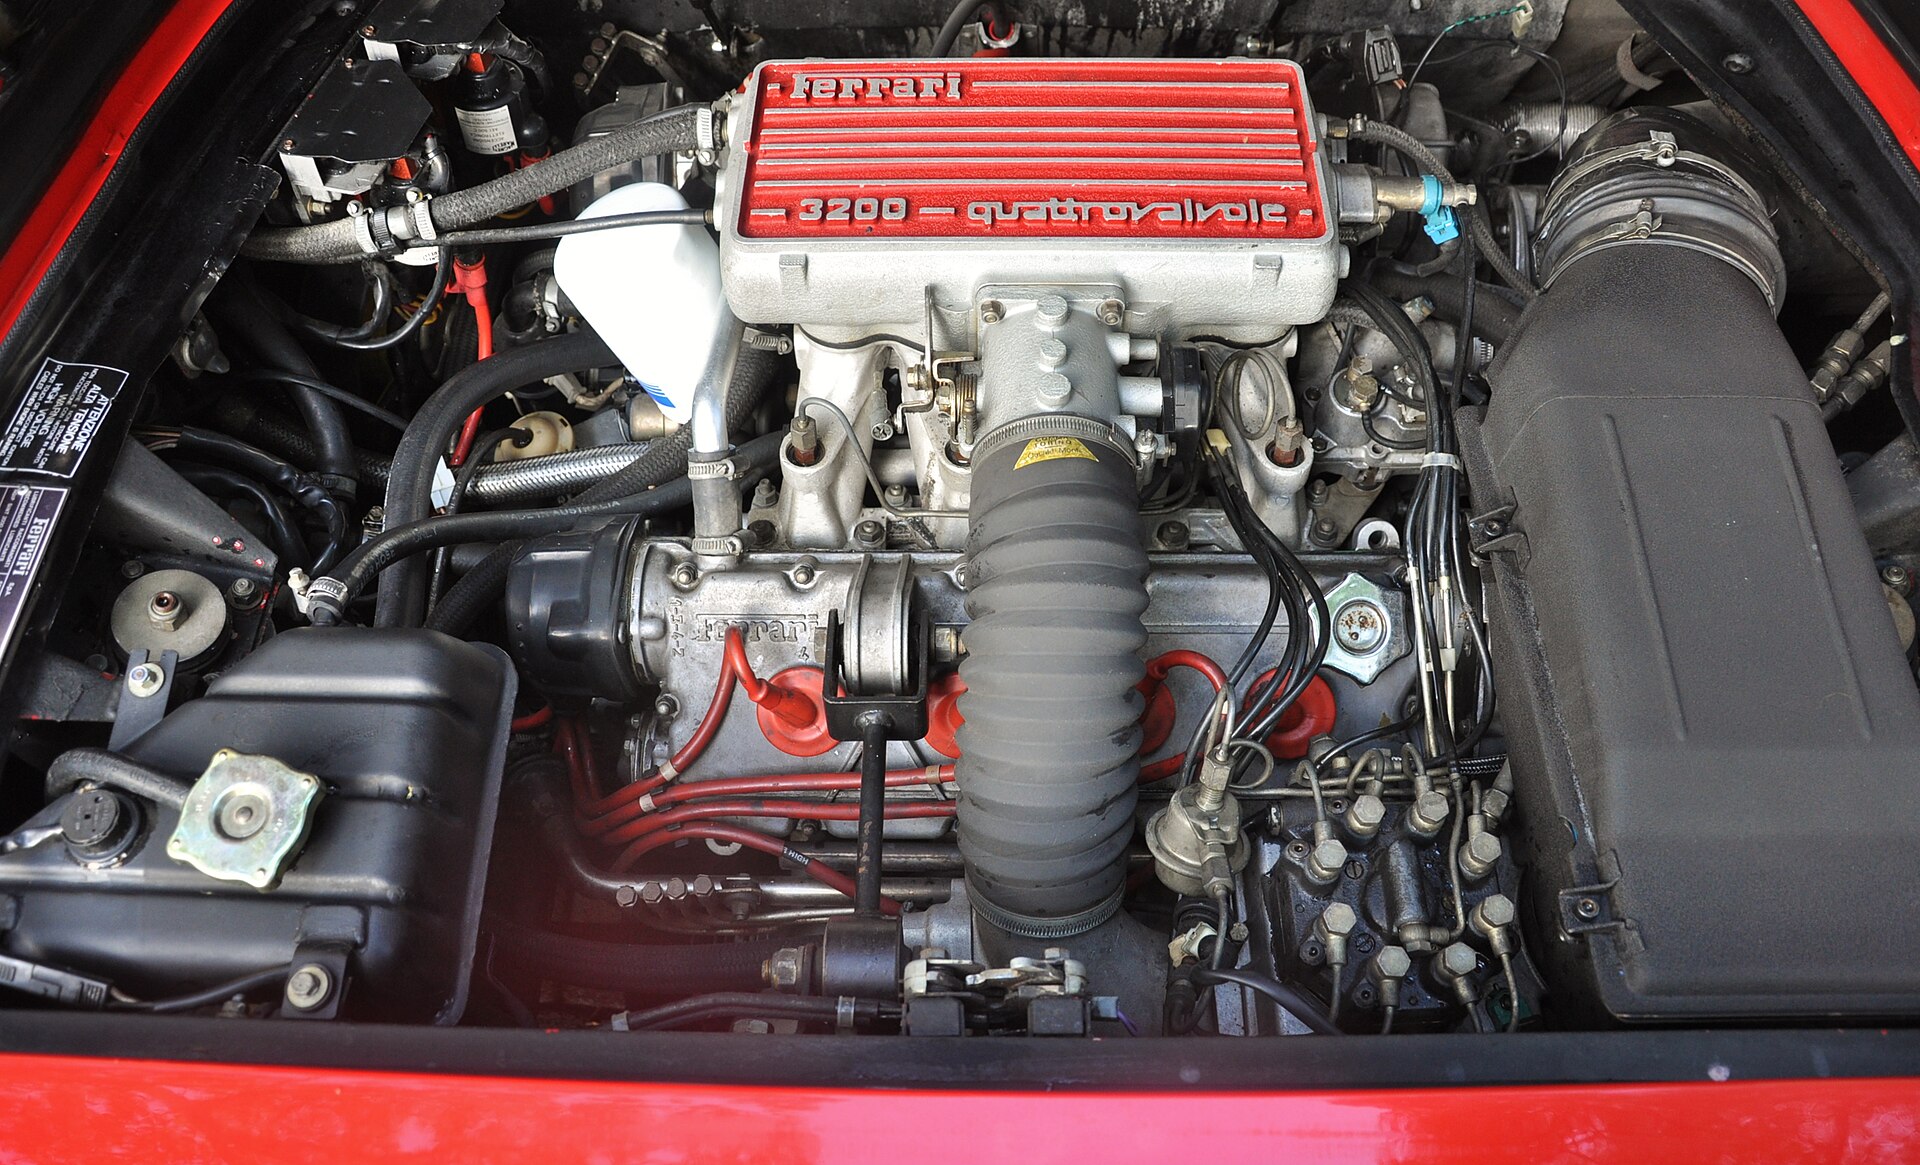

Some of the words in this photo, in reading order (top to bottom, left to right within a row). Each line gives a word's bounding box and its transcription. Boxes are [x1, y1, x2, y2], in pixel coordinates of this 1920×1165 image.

[790, 72, 961, 99] Ferrari
[799, 198, 906, 220] 3200
[967, 197, 1287, 225] quattrovalvole
[47, 373, 57, 383] NOT
[54, 364, 62, 372] DO
[87, 367, 98, 378] NON
[35, 370, 51, 389] CABLES
[26, 391, 39, 406] WHEN
[37, 384, 51, 400] TOUCH
[44, 382, 63, 404] HIGH
[82, 383, 102, 404] ALTA
[15, 407, 30, 425] ENGINE
[32, 401, 41, 410] OR
[37, 392, 68, 436] WARNING
[58, 406, 68, 418] CON
[14, 411, 35, 442] DISCONNECT
[19, 407, 49, 448] VOLTAGE
[45, 419, 61, 440] MOTORE
[54, 406, 89, 454] TENSIONE
[69, 394, 110, 451] ATTENZIONE
[1, 444, 17, 466] IGNITION
[552, 500, 621, 516] AUSTRALIA
[10, 515, 51, 577] Ferrari
[374, 548, 396, 569] HOSE
[788, 849, 809, 865] HIGH
